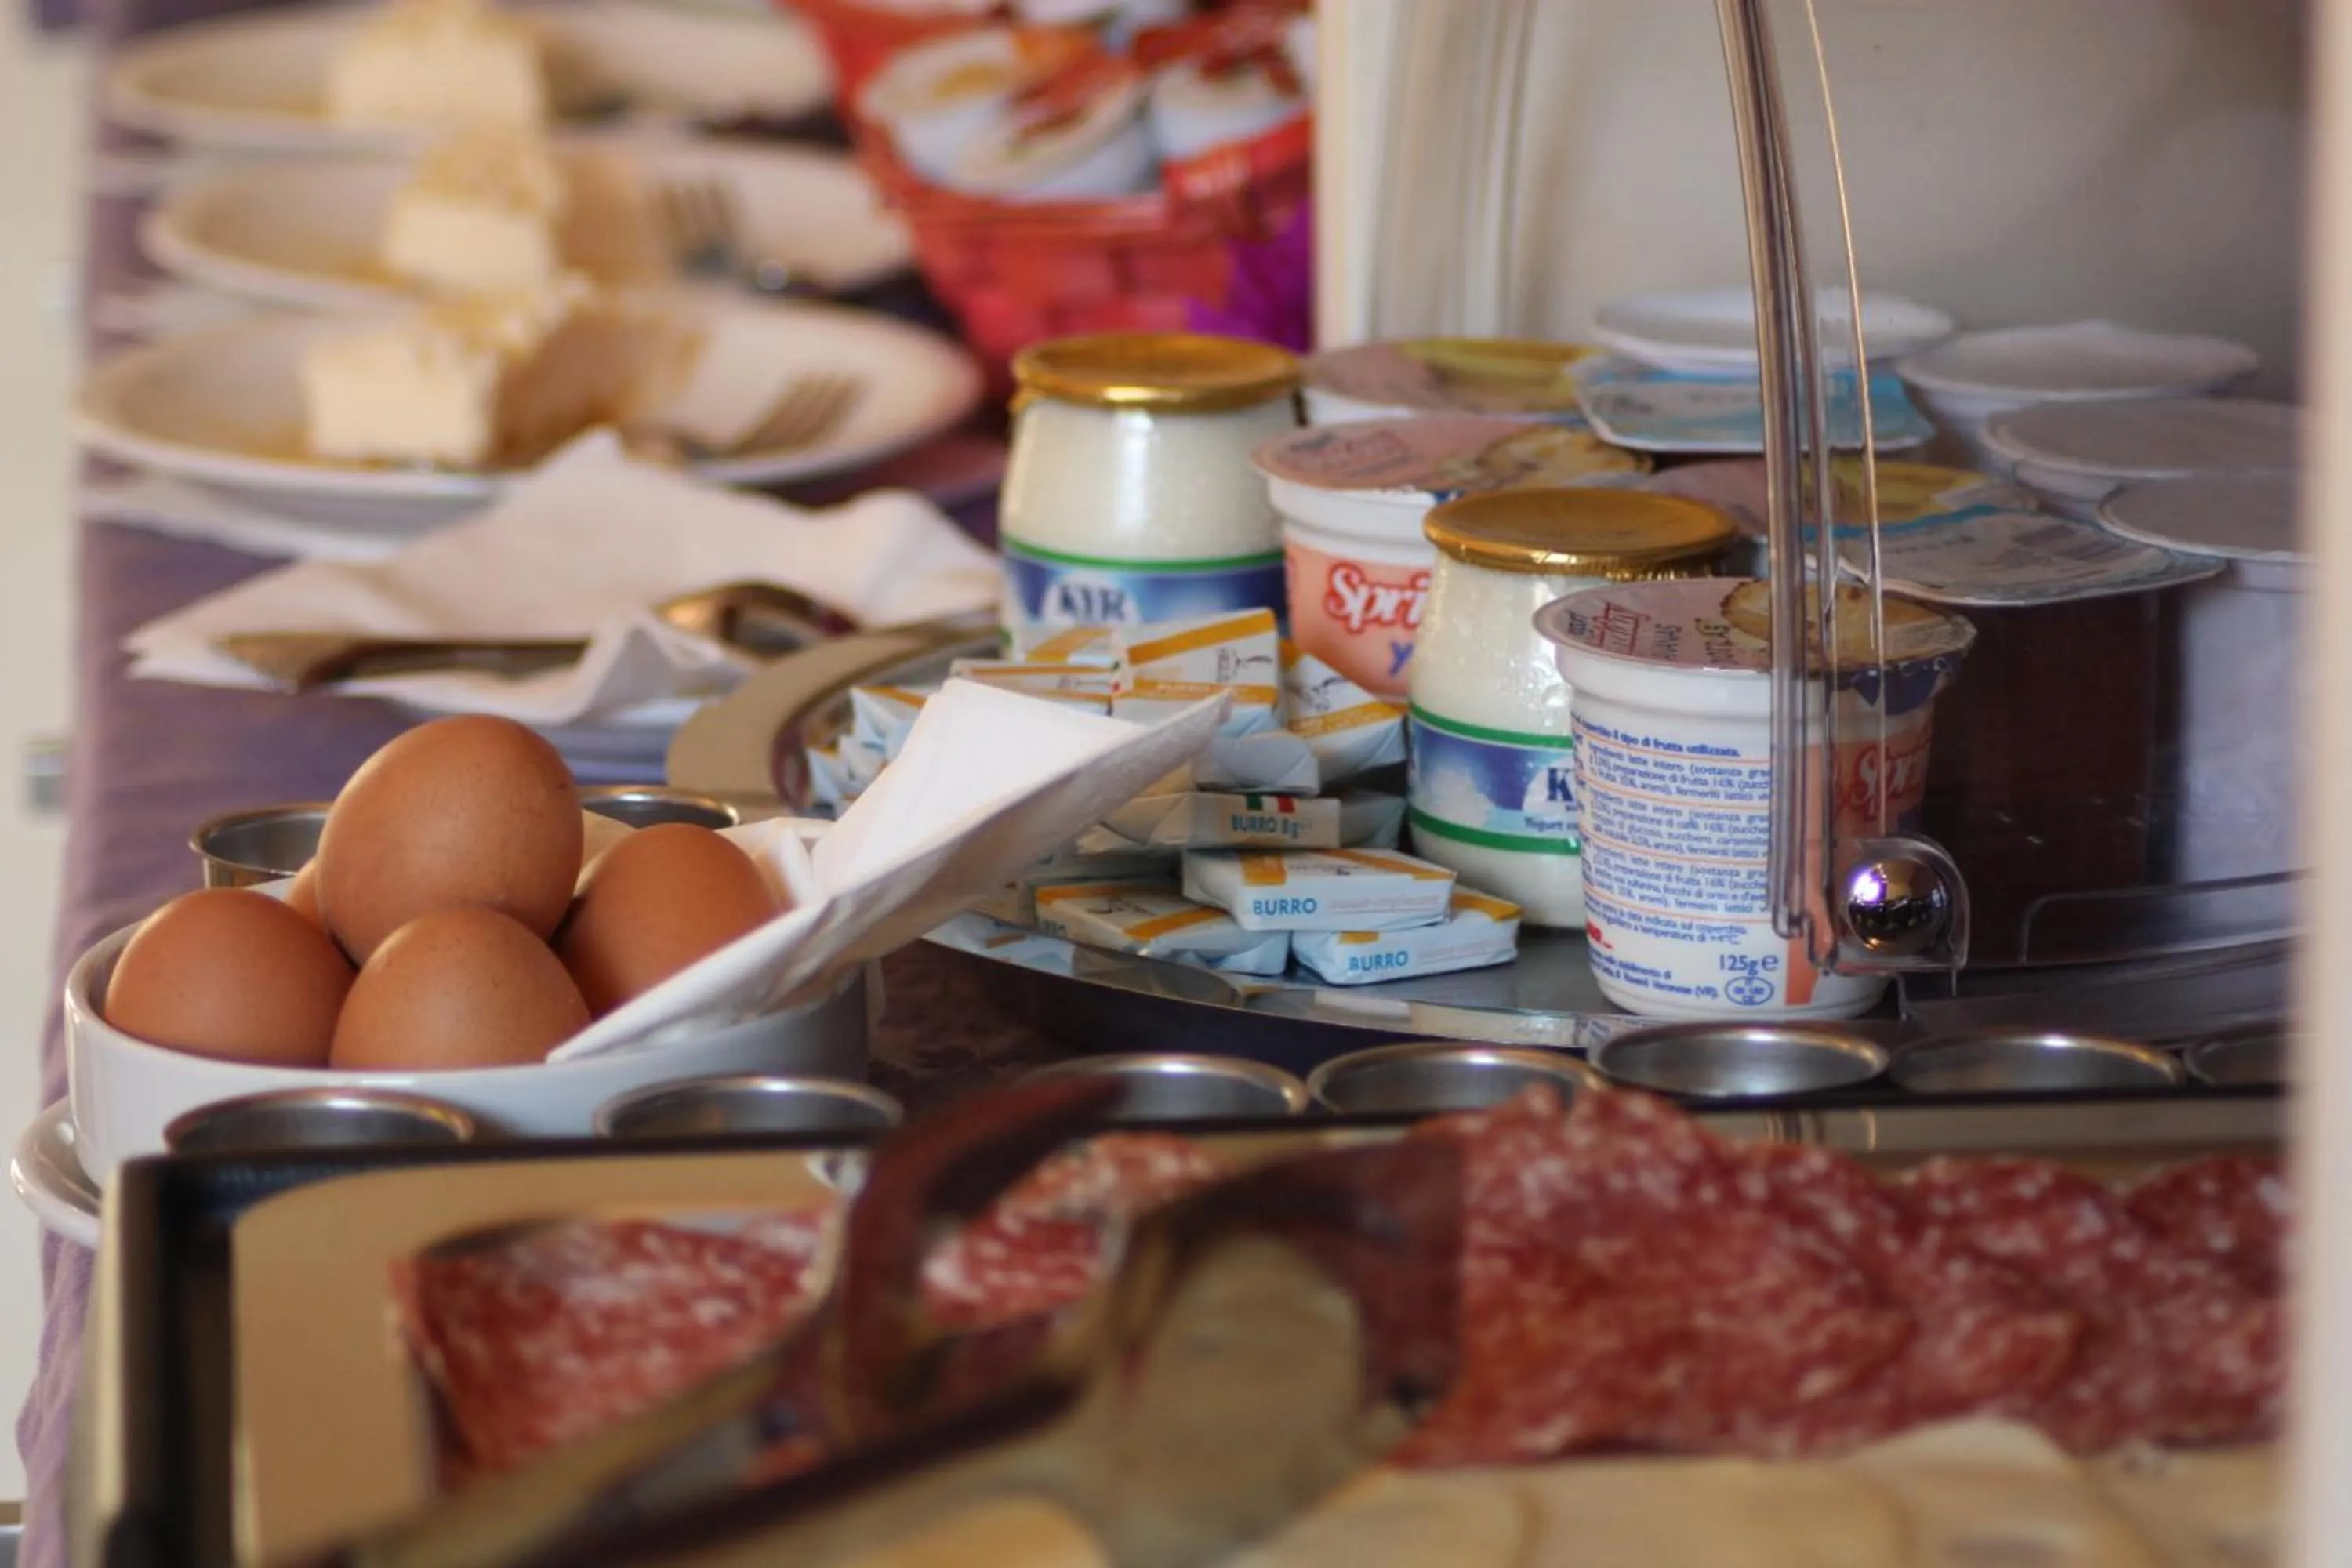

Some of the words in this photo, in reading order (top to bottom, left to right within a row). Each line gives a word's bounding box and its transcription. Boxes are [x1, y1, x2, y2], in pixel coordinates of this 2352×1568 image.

[1253, 898, 1318, 916] BURRO
[1348, 950, 1409, 971] BURRO
[1719, 954, 1759, 978] 125g
